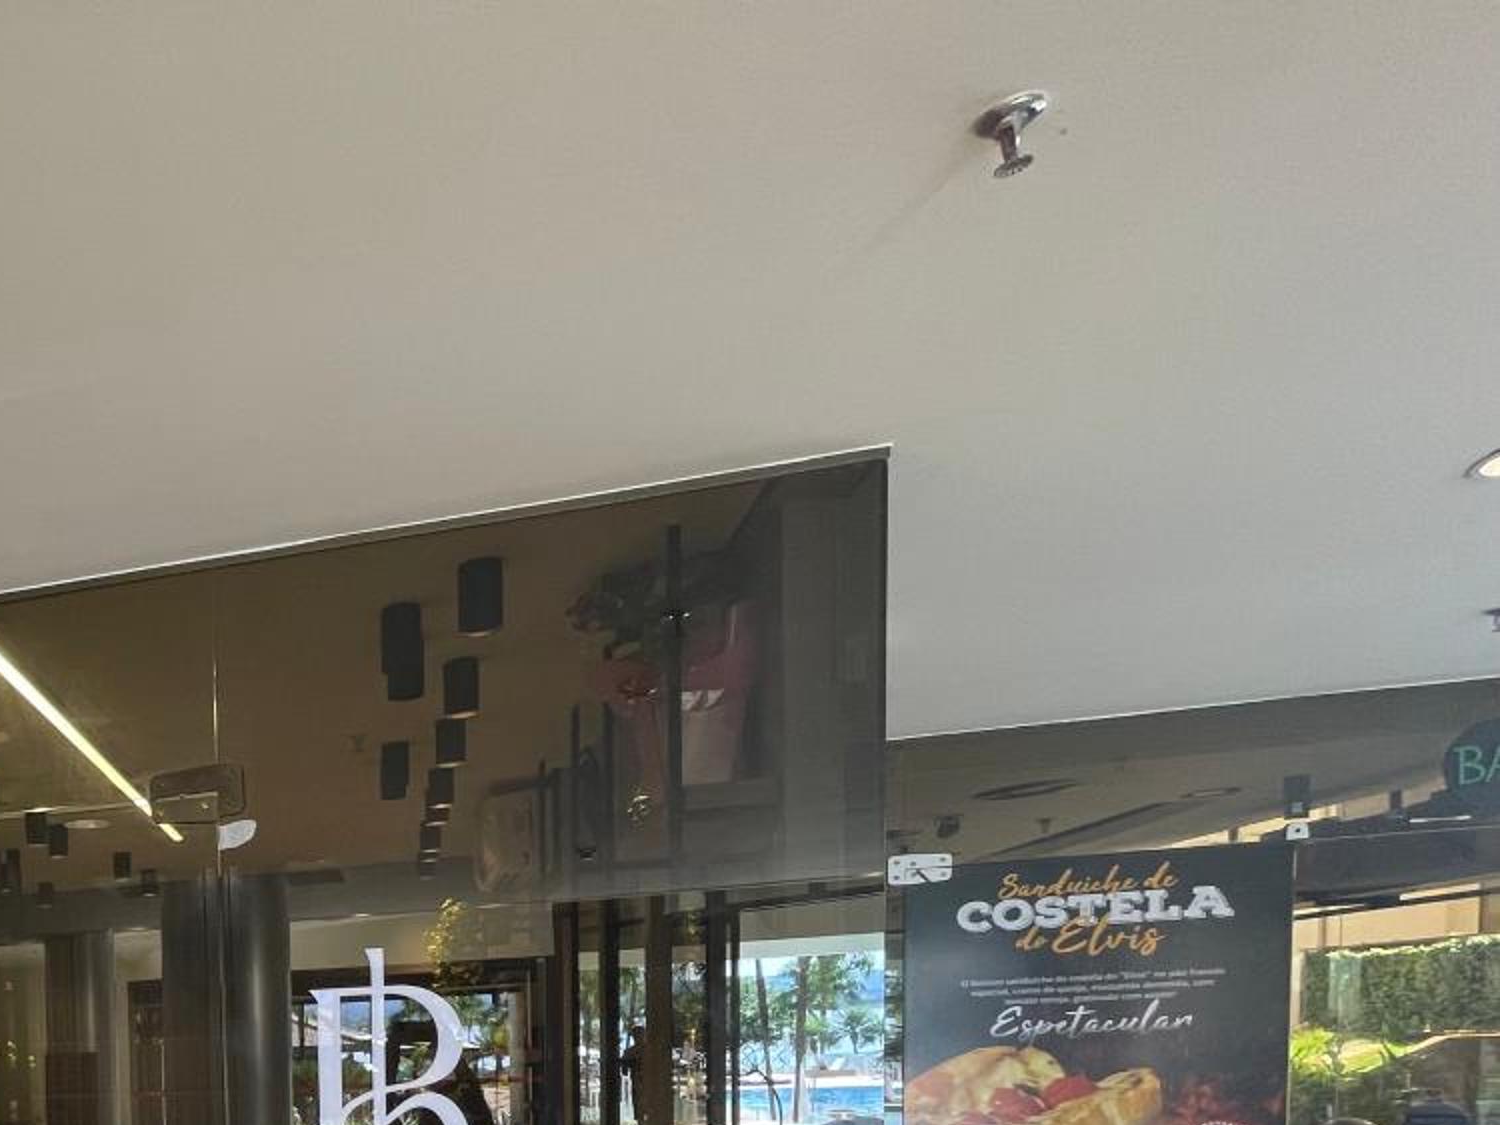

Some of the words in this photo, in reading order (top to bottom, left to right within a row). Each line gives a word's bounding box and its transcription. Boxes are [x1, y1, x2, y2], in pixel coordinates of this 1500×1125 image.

[1143, 860, 1180, 889] de
[956, 885, 1235, 932] COSTELA
[1051, 914, 1168, 956] Elvis
